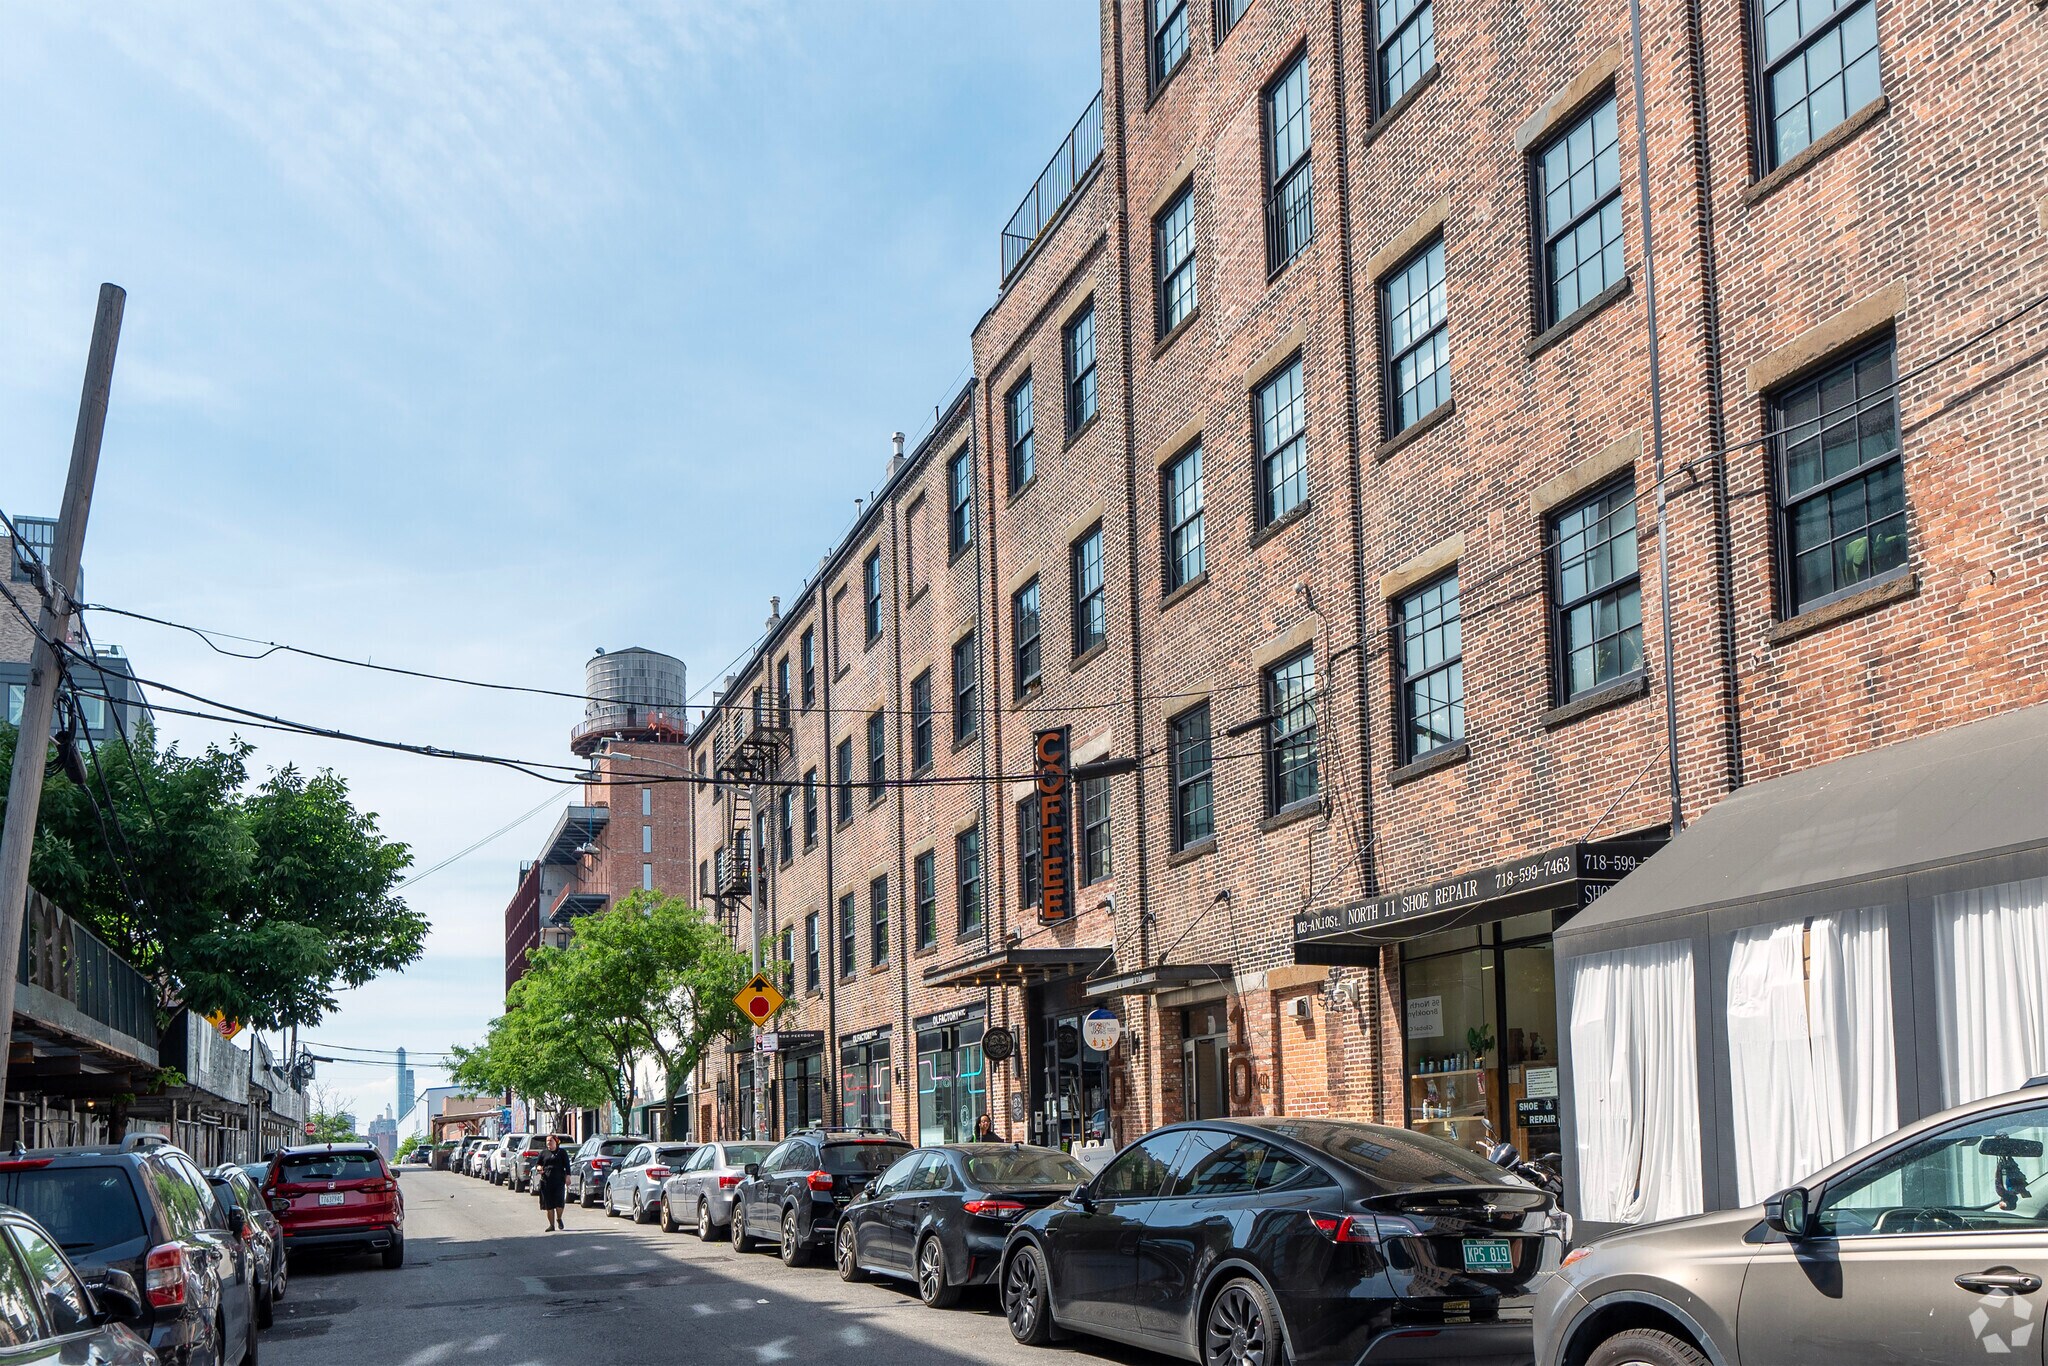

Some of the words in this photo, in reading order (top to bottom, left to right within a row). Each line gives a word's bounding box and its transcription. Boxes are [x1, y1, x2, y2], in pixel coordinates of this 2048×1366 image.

[1037, 732, 1065, 919] COFFEE
[1584, 854, 1650, 871] 718-599-
[1495, 856, 1570, 889] 718-599-7463
[1348, 904, 1379, 925] NORTH
[1384, 900, 1396, 917] 11
[1402, 891, 1430, 913] SHOE
[1434, 879, 1478, 906] REPAIR
[932, 1010, 959, 1025] OLFACTORY
[1519, 1102, 1538, 1111] SHOE
[1529, 1114, 1556, 1124] REPAIR
[1467, 1247, 1486, 1262] KPS
[1489, 1246, 1508, 1262] 819
